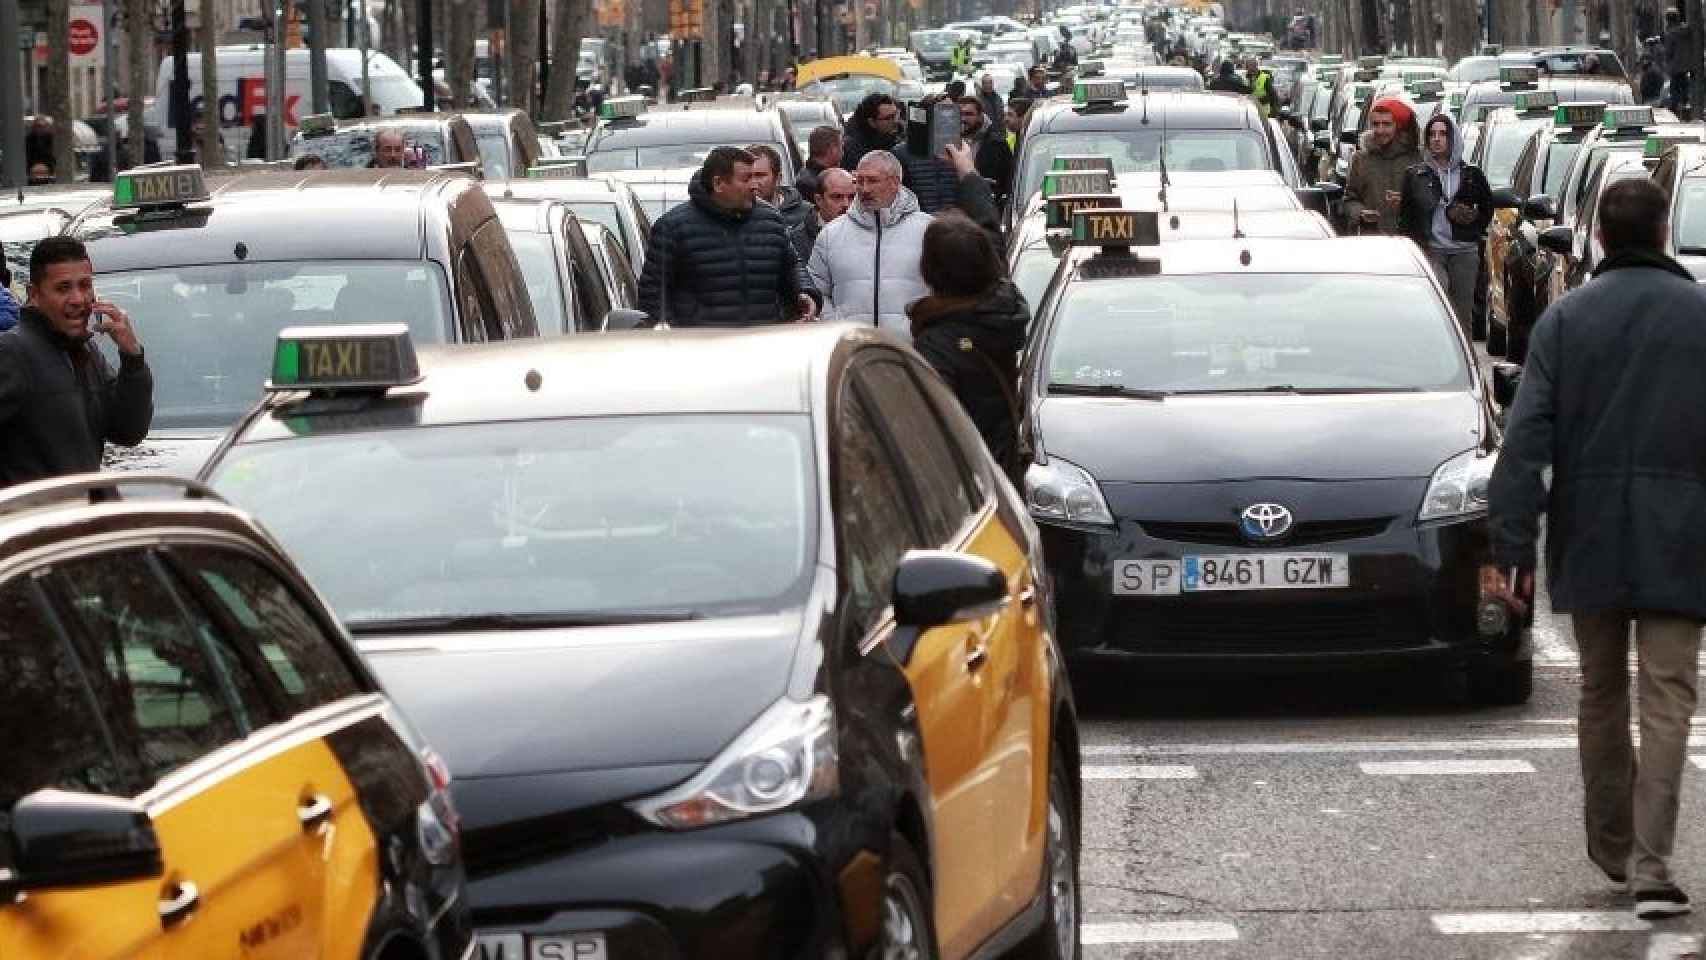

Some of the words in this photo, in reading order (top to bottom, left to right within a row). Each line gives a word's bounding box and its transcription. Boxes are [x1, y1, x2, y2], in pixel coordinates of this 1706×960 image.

[136, 174, 178, 199] TAXI
[1090, 215, 1134, 239] TAXI
[304, 342, 362, 377] TAXI
[1203, 559, 1266, 585] 8461
[1283, 557, 1333, 584] GZW
